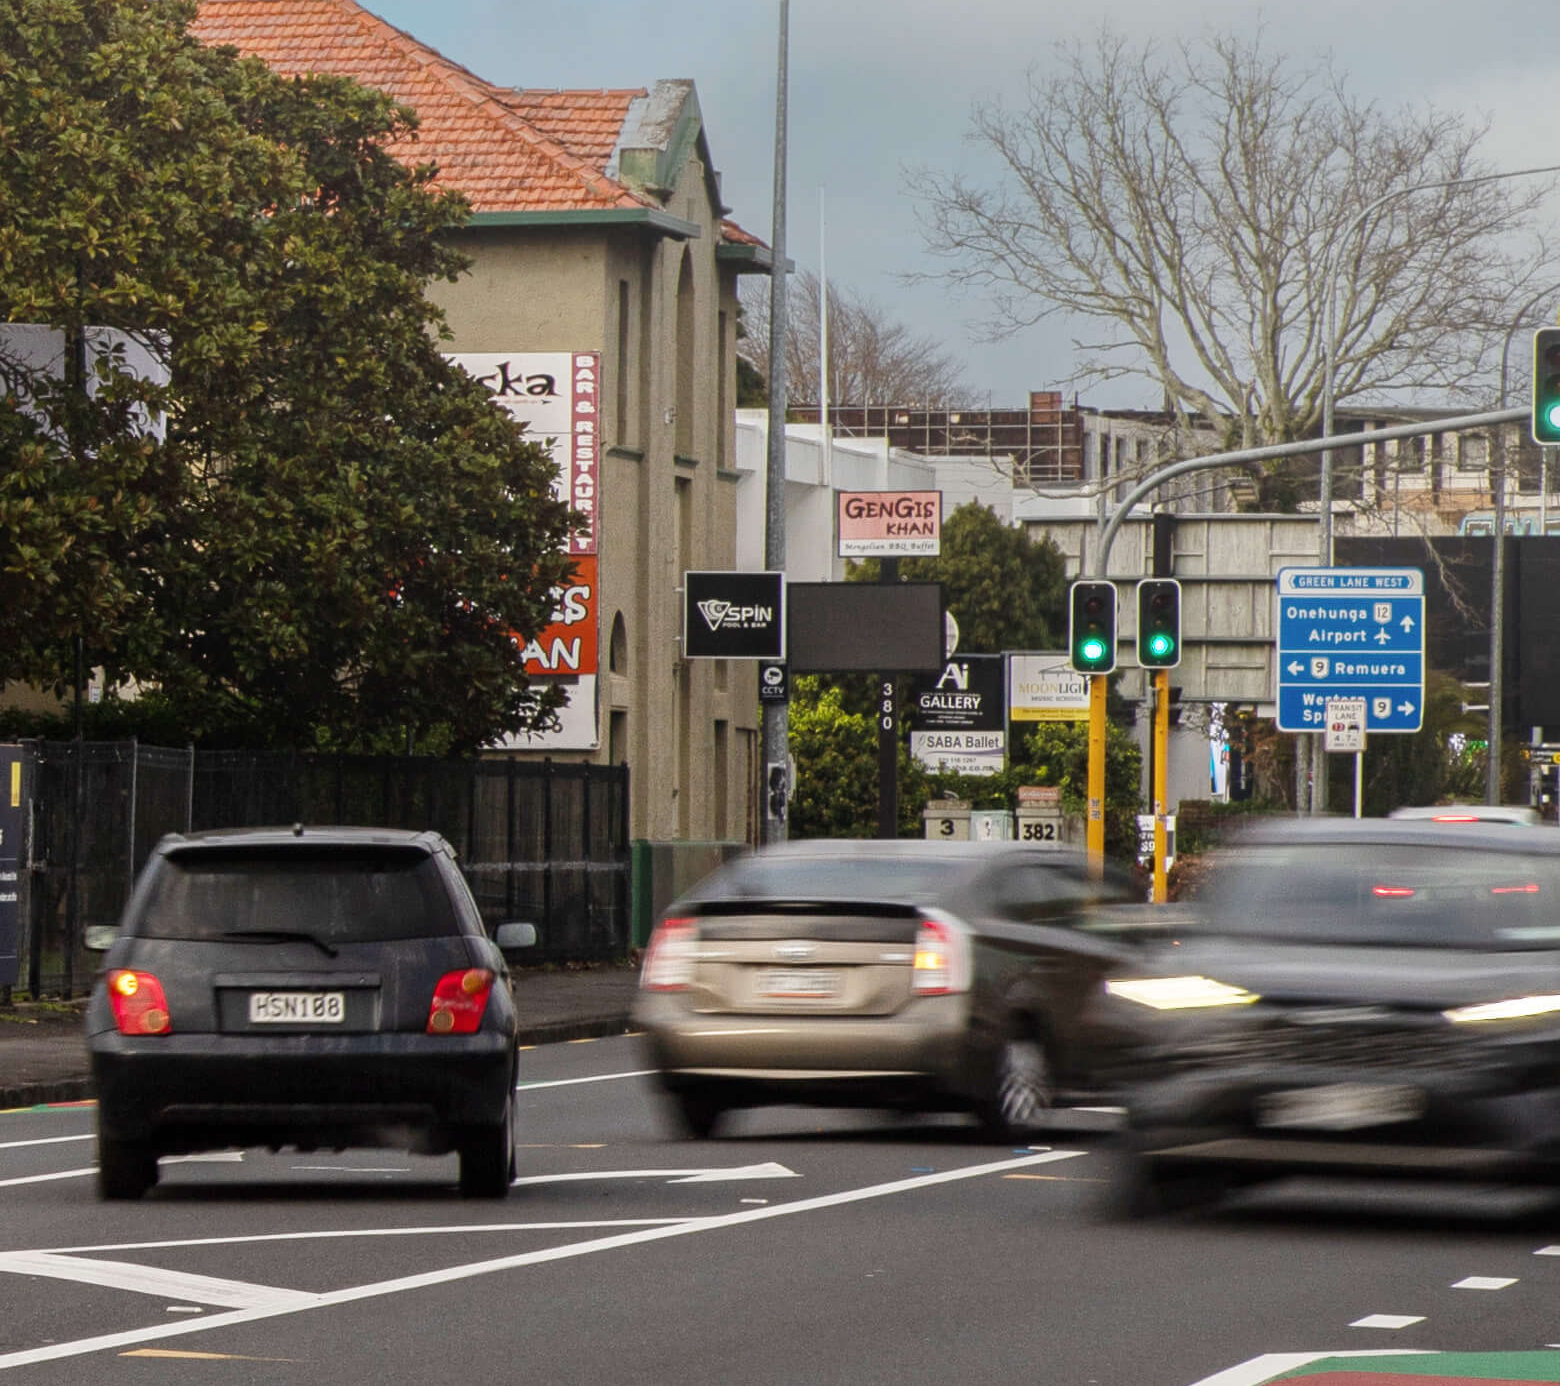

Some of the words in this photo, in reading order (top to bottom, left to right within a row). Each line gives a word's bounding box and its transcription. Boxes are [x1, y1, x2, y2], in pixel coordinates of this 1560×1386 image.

[575, 355, 594, 393] BAR
[575, 400, 595, 413] &
[575, 421, 594, 550] RESTAURT
[886, 522, 934, 535] KHAN
[889, 542, 907, 551] BBQ
[1298, 577, 1334, 587] GREEN
[1340, 577, 1369, 587] LANE
[1375, 577, 1403, 587] WEST
[1287, 607, 1367, 623] Onehunga
[1375, 606, 1389, 618] 12
[1309, 629, 1367, 644] Airport
[1315, 661, 1325, 673] 9
[1335, 662, 1406, 675] Remuera
[936, 663, 968, 690] Ai
[762, 686, 784, 694] CCTV
[883, 683, 893, 730] 380
[920, 695, 981, 709] GALLERY
[1377, 701, 1387, 713] 9
[927, 736, 961, 748] SABA
[966, 736, 1000, 748] Ballet
[940, 819, 954, 836] 3
[1023, 824, 1054, 841] 382
